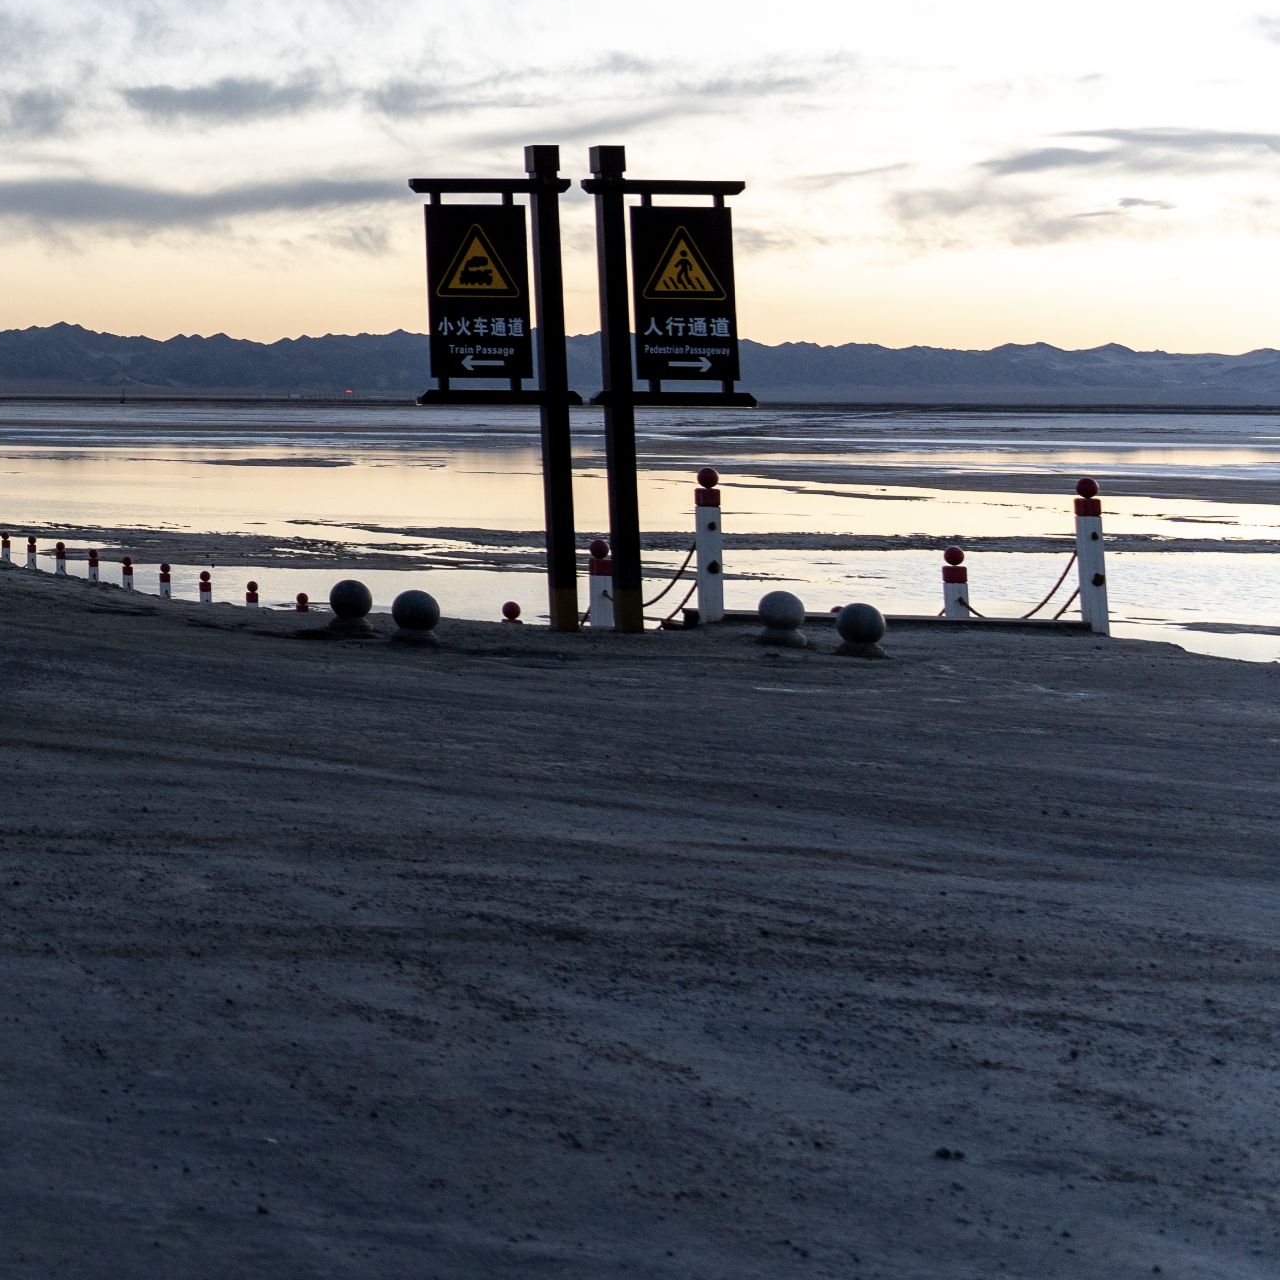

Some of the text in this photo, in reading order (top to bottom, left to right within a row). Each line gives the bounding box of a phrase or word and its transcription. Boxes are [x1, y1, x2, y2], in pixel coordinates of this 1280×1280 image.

[437, 316, 525, 337] 小火车通道
[643, 316, 731, 337] 人行通道
[448, 344, 515, 357] Train Passage
[644, 344, 731, 357] Pedestrian Passageway
